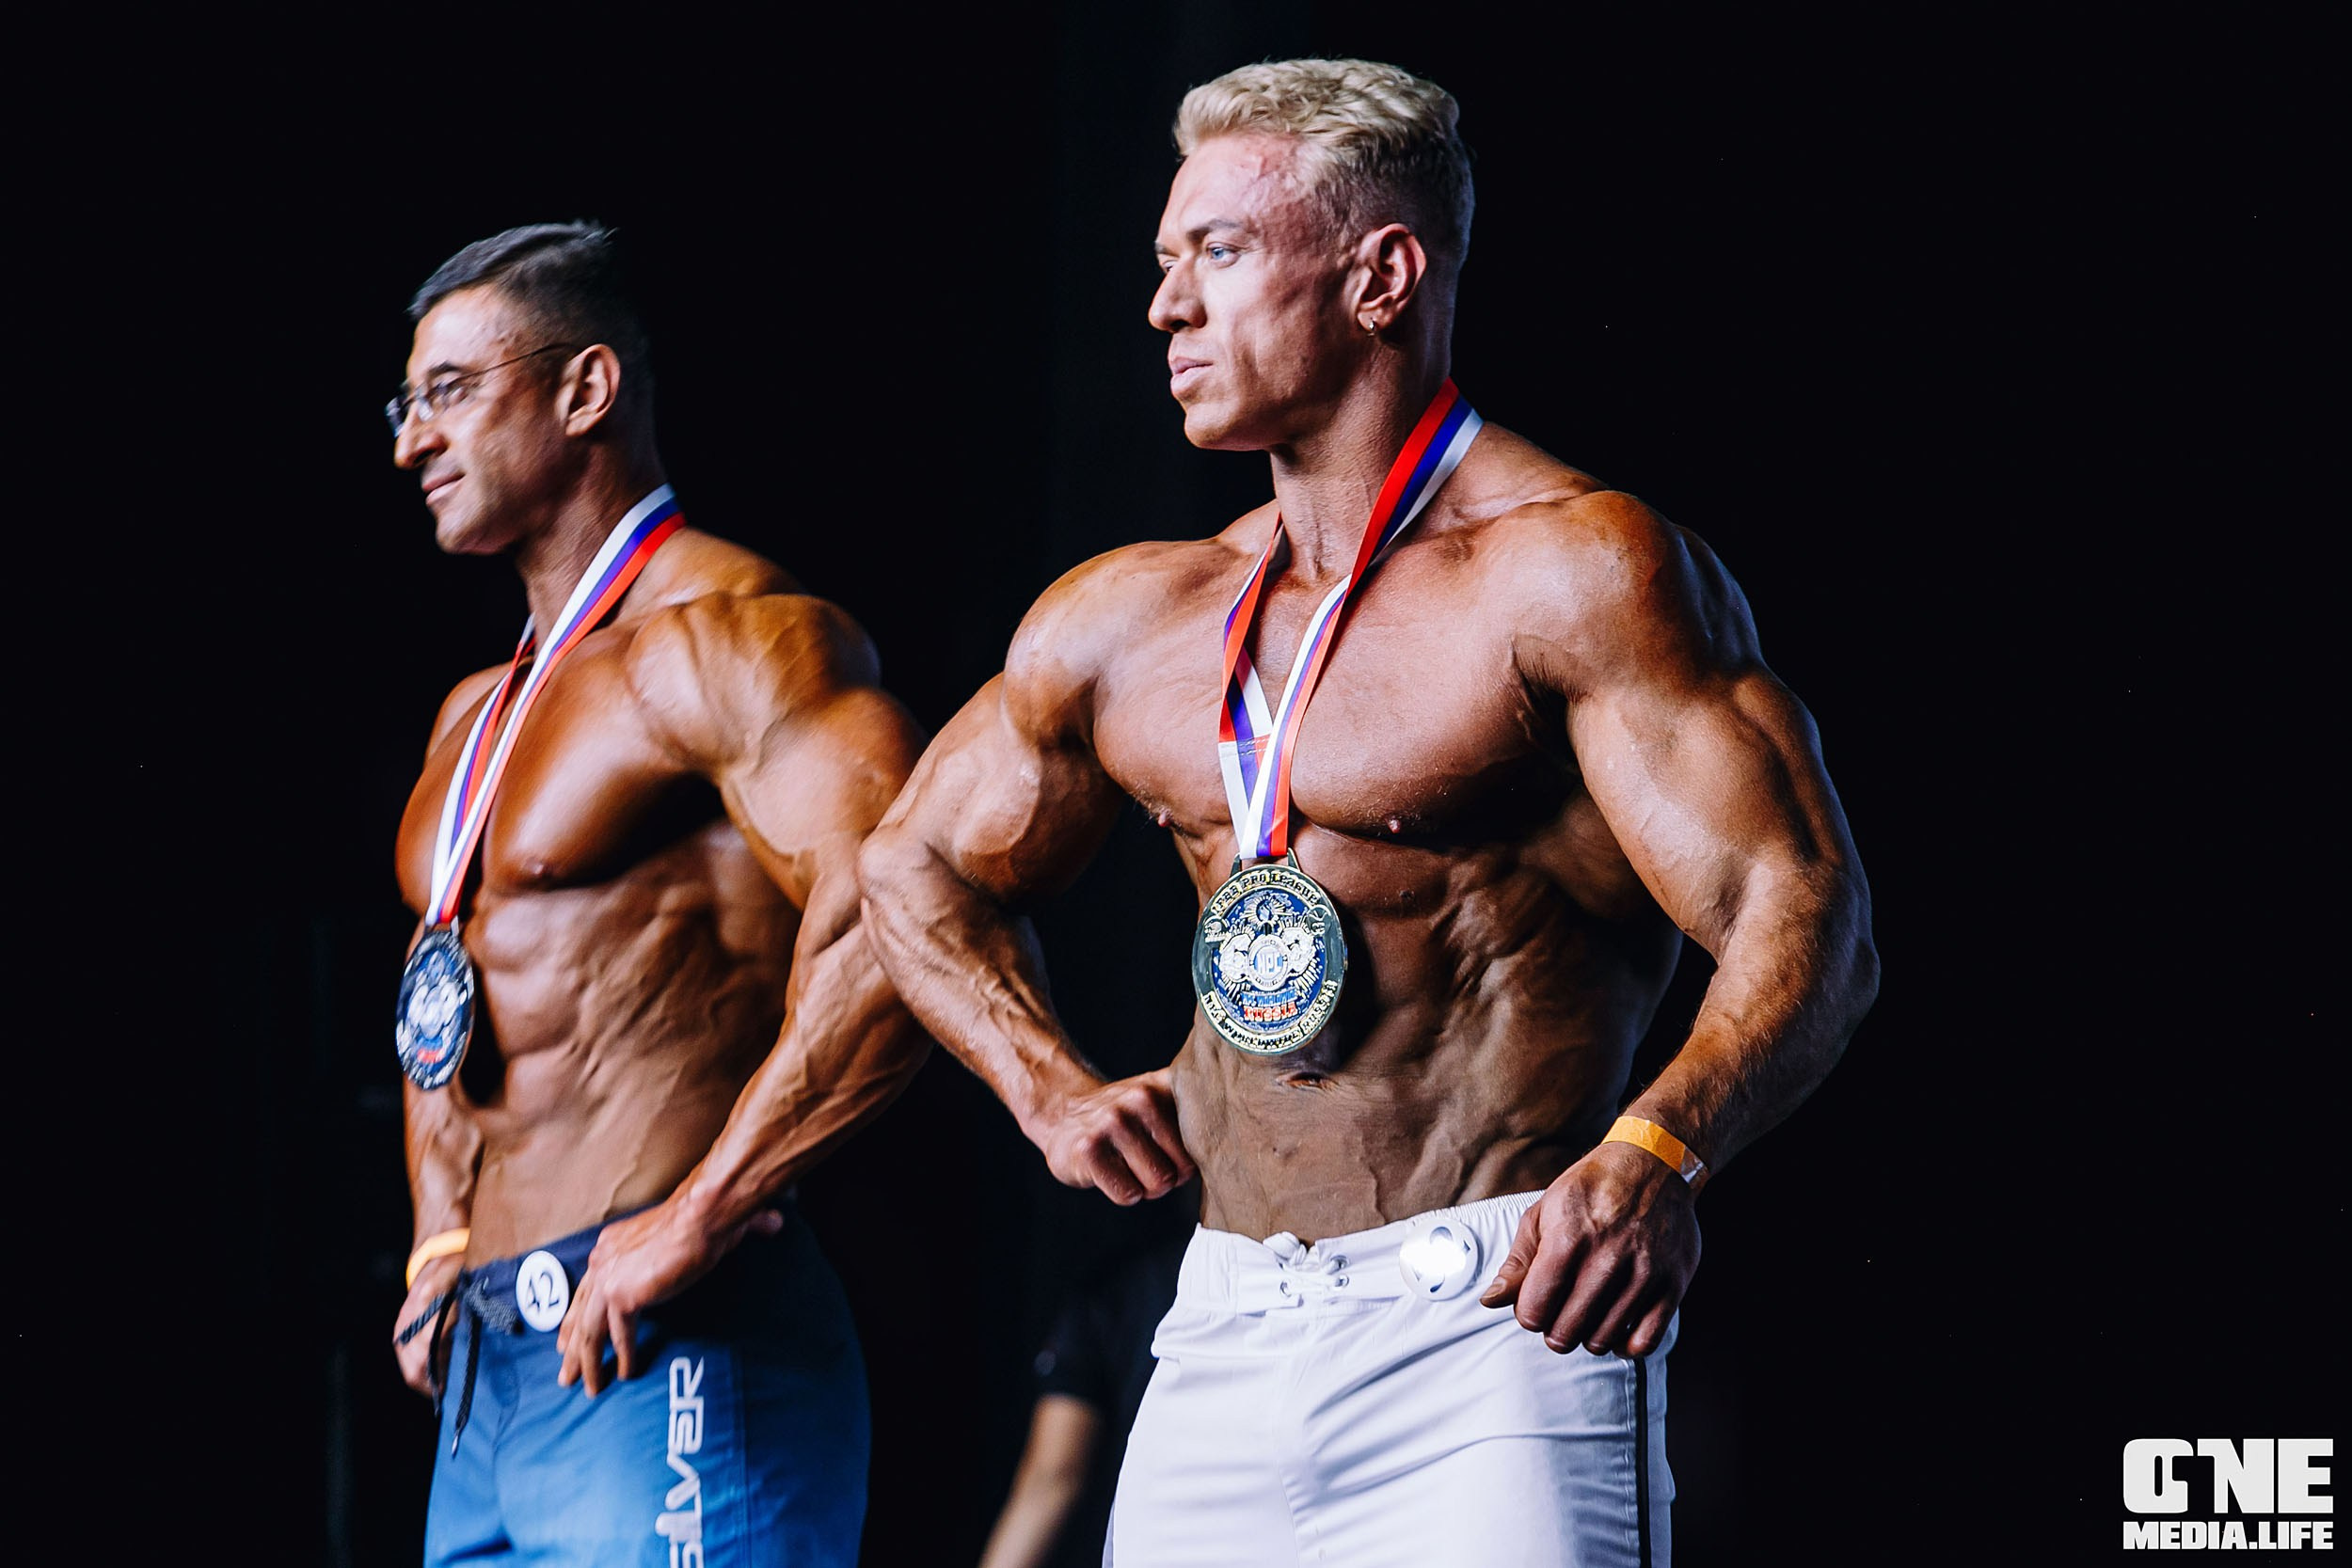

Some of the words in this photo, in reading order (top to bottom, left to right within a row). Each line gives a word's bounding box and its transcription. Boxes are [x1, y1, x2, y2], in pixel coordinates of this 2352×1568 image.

[1242, 870, 1269, 888] PRO
[1244, 1002, 1298, 1022] RUSSIA
[526, 1268, 560, 1313] 42
